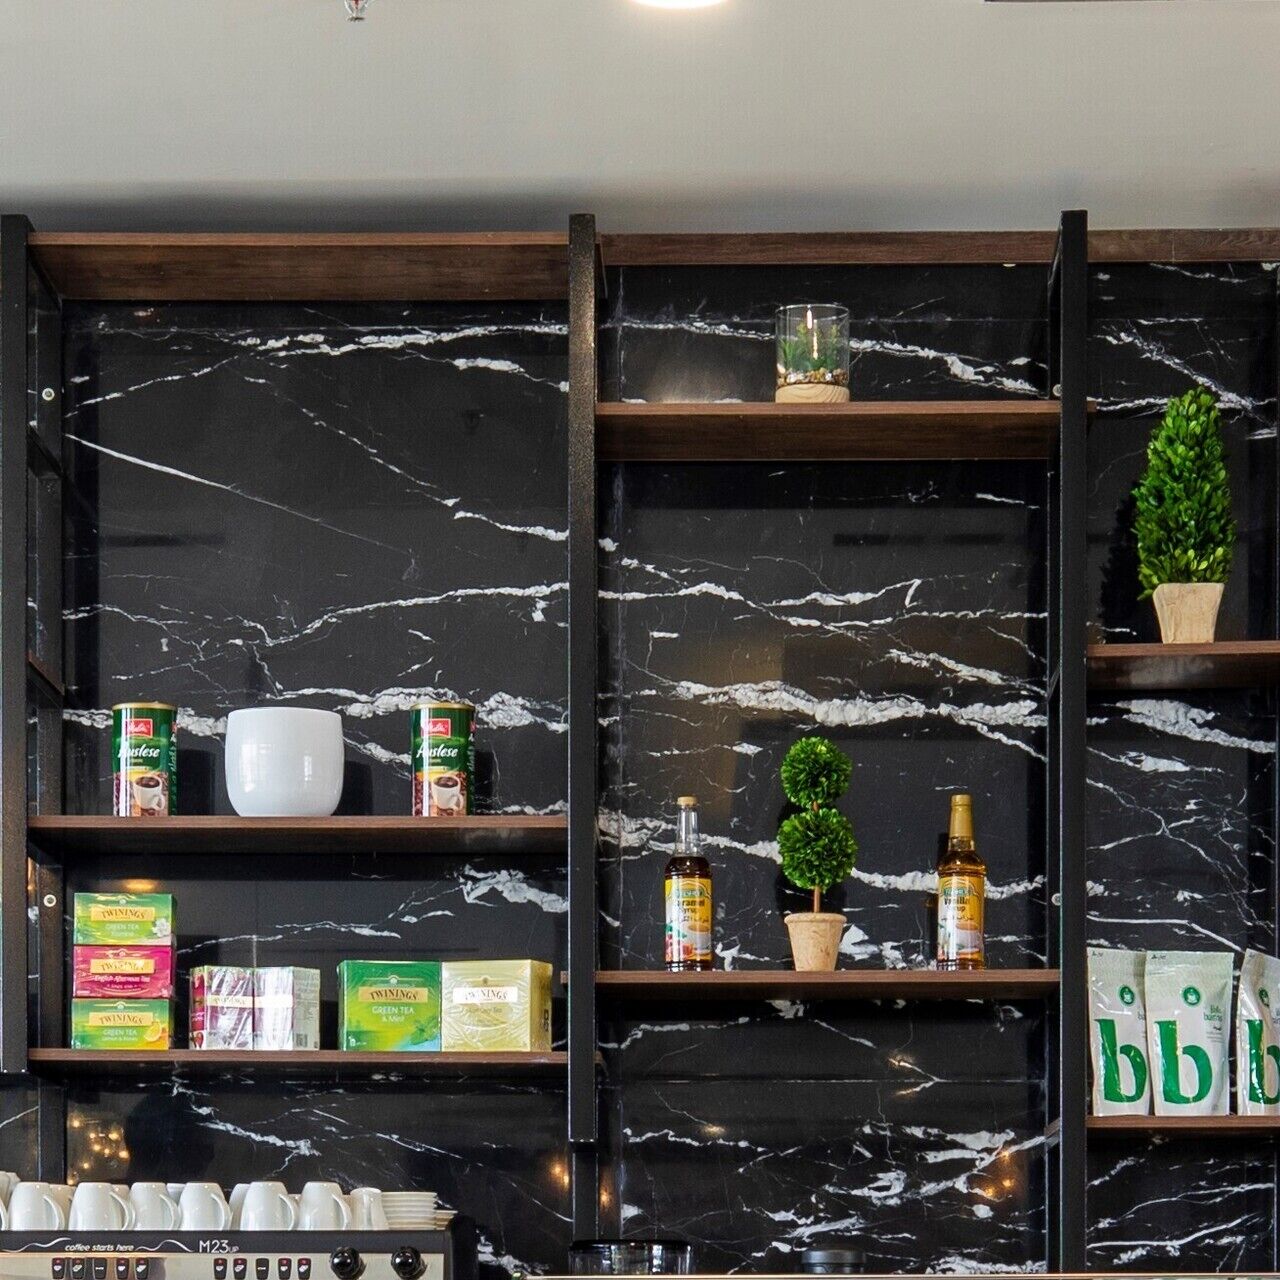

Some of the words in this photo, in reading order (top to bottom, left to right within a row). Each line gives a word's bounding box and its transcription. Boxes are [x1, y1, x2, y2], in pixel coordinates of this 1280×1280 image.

[101, 908, 145, 920] TWININGS
[370, 988, 418, 1001] TWININGS
[465, 988, 508, 1000] WNINGS
[372, 1005, 398, 1014] GREEN
[400, 1006, 414, 1014] TEA
[100, 1013, 144, 1025] TWININGS
[1094, 1019, 1147, 1103] b
[1154, 1020, 1213, 1105] b
[64, 1243, 90, 1251] coffee
[115, 1243, 135, 1251] here
